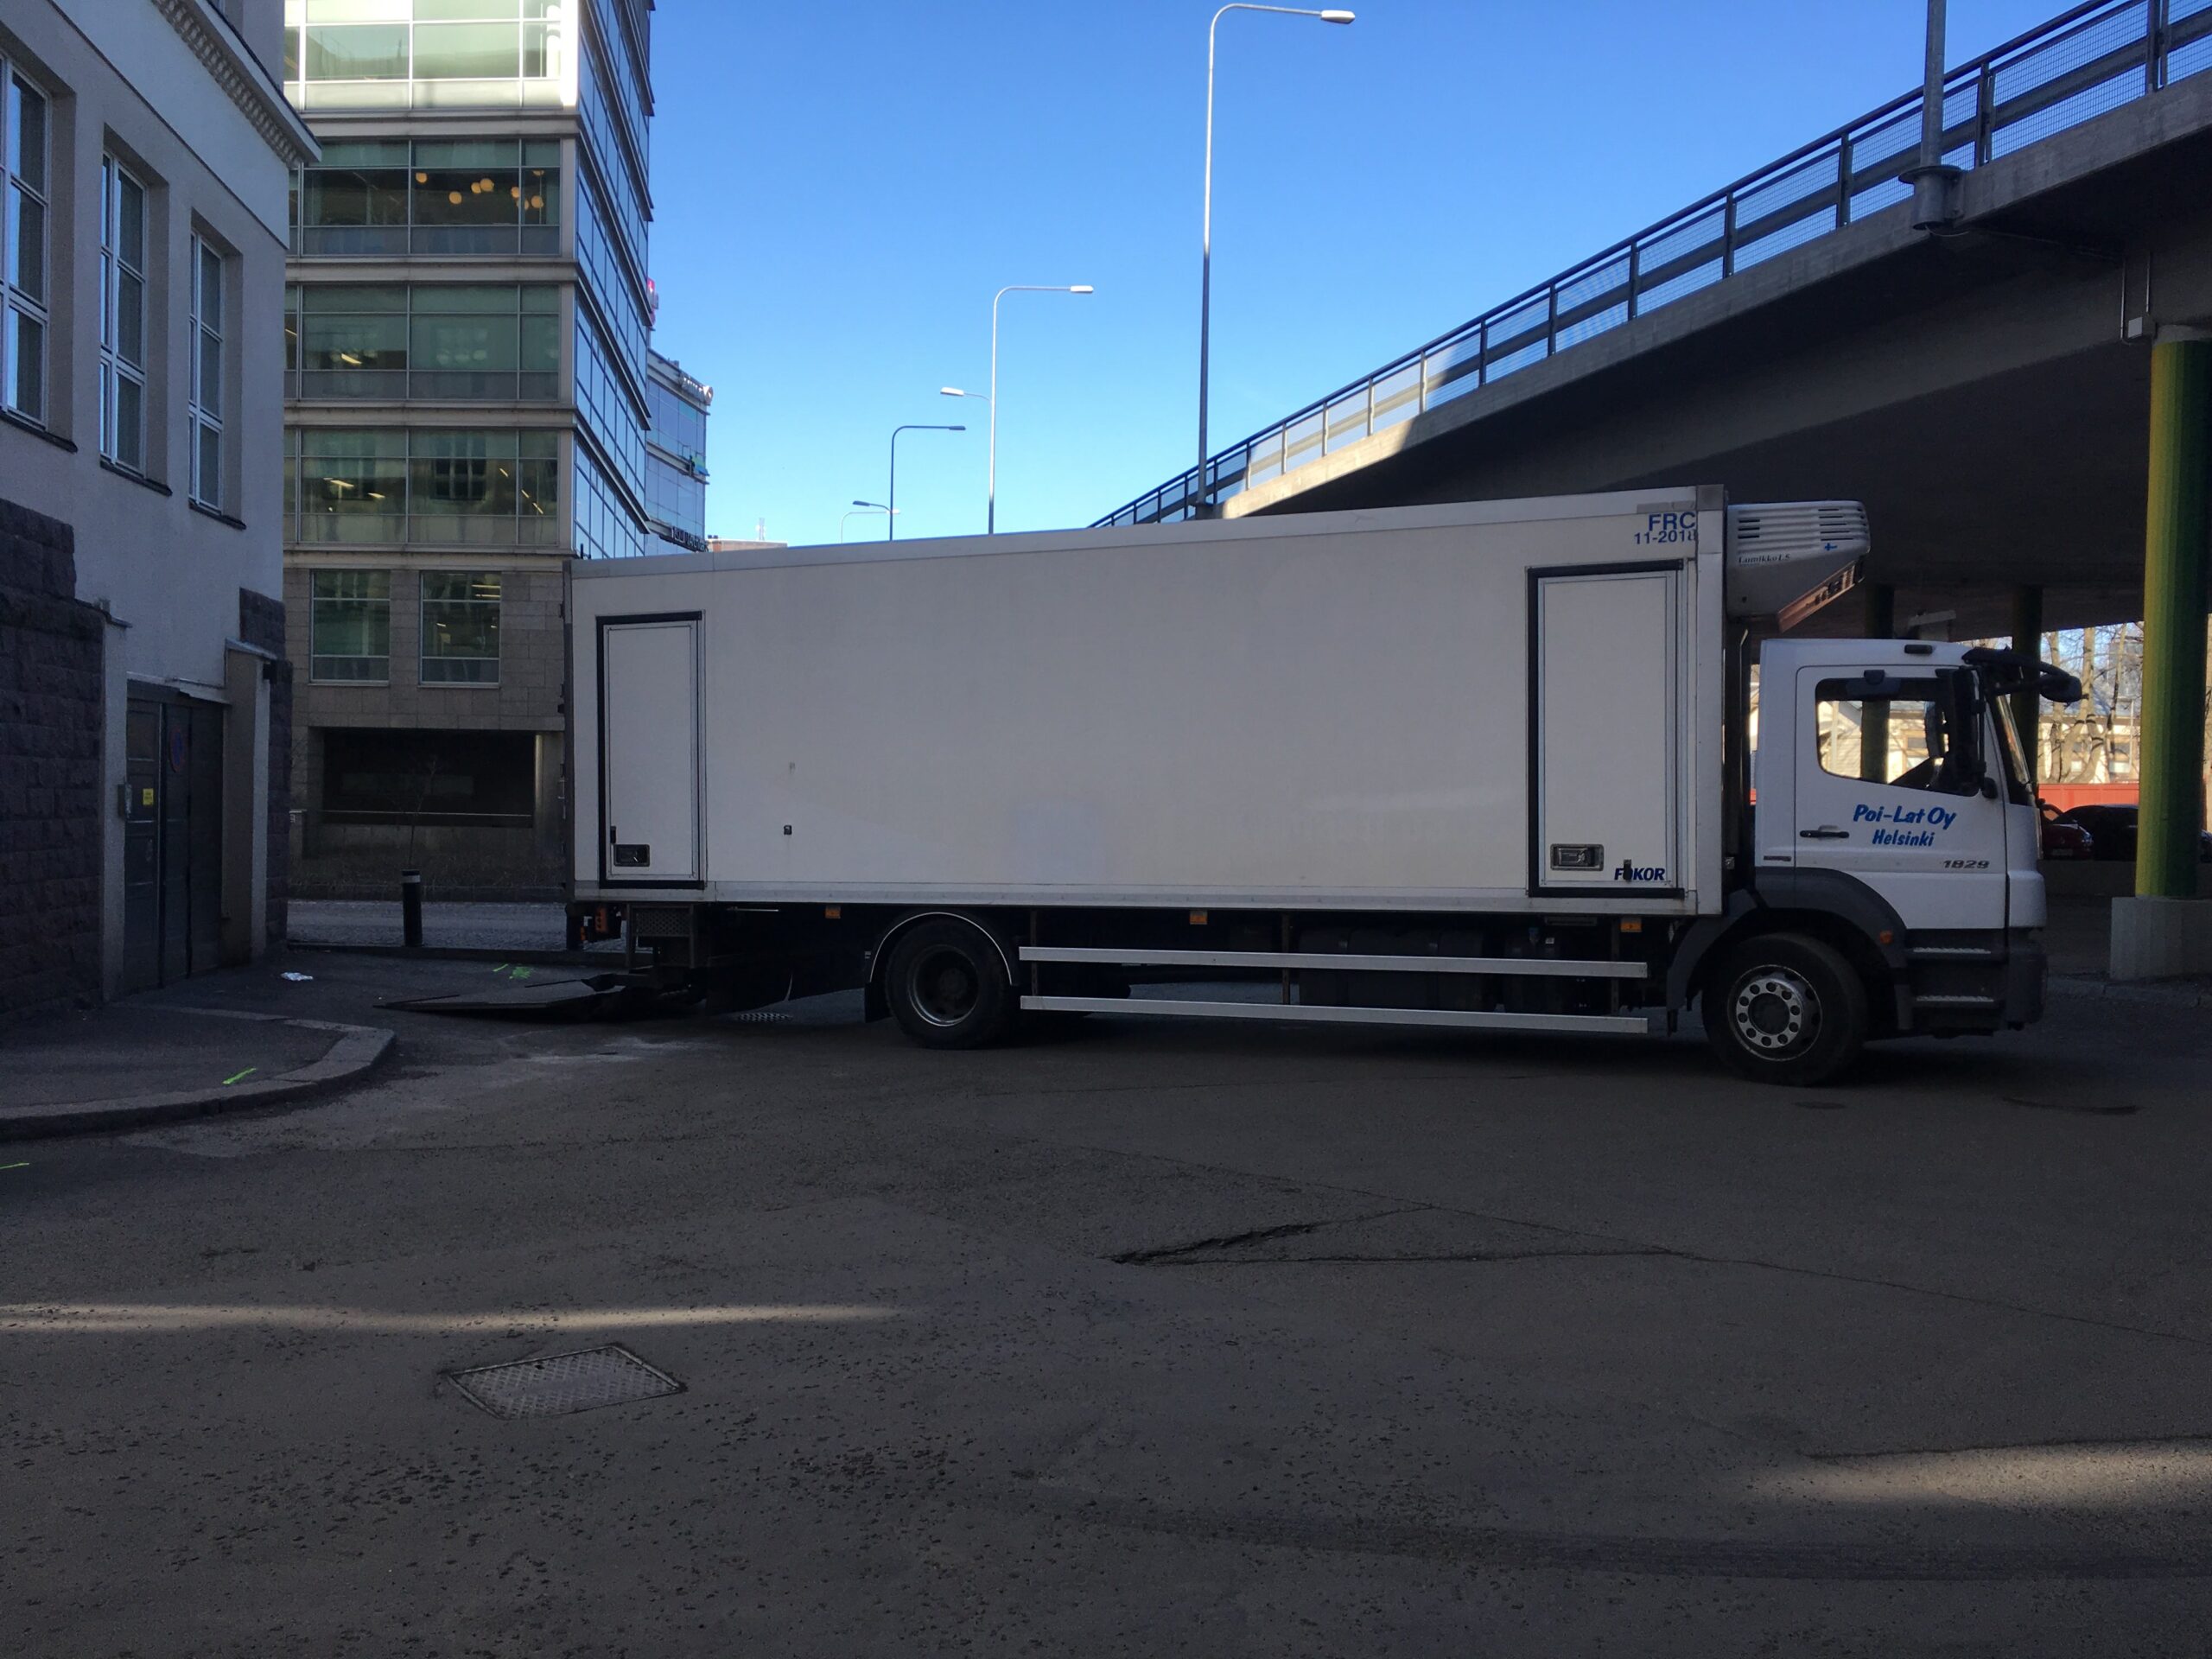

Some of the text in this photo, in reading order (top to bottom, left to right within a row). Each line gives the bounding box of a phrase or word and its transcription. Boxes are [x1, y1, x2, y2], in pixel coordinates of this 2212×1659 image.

[1649, 512, 1695, 531] FRC
[1853, 804, 1957, 830] Poi-Lat Oy
[1872, 829, 1936, 847] Helsinki
[1943, 860, 1991, 869] 1829
